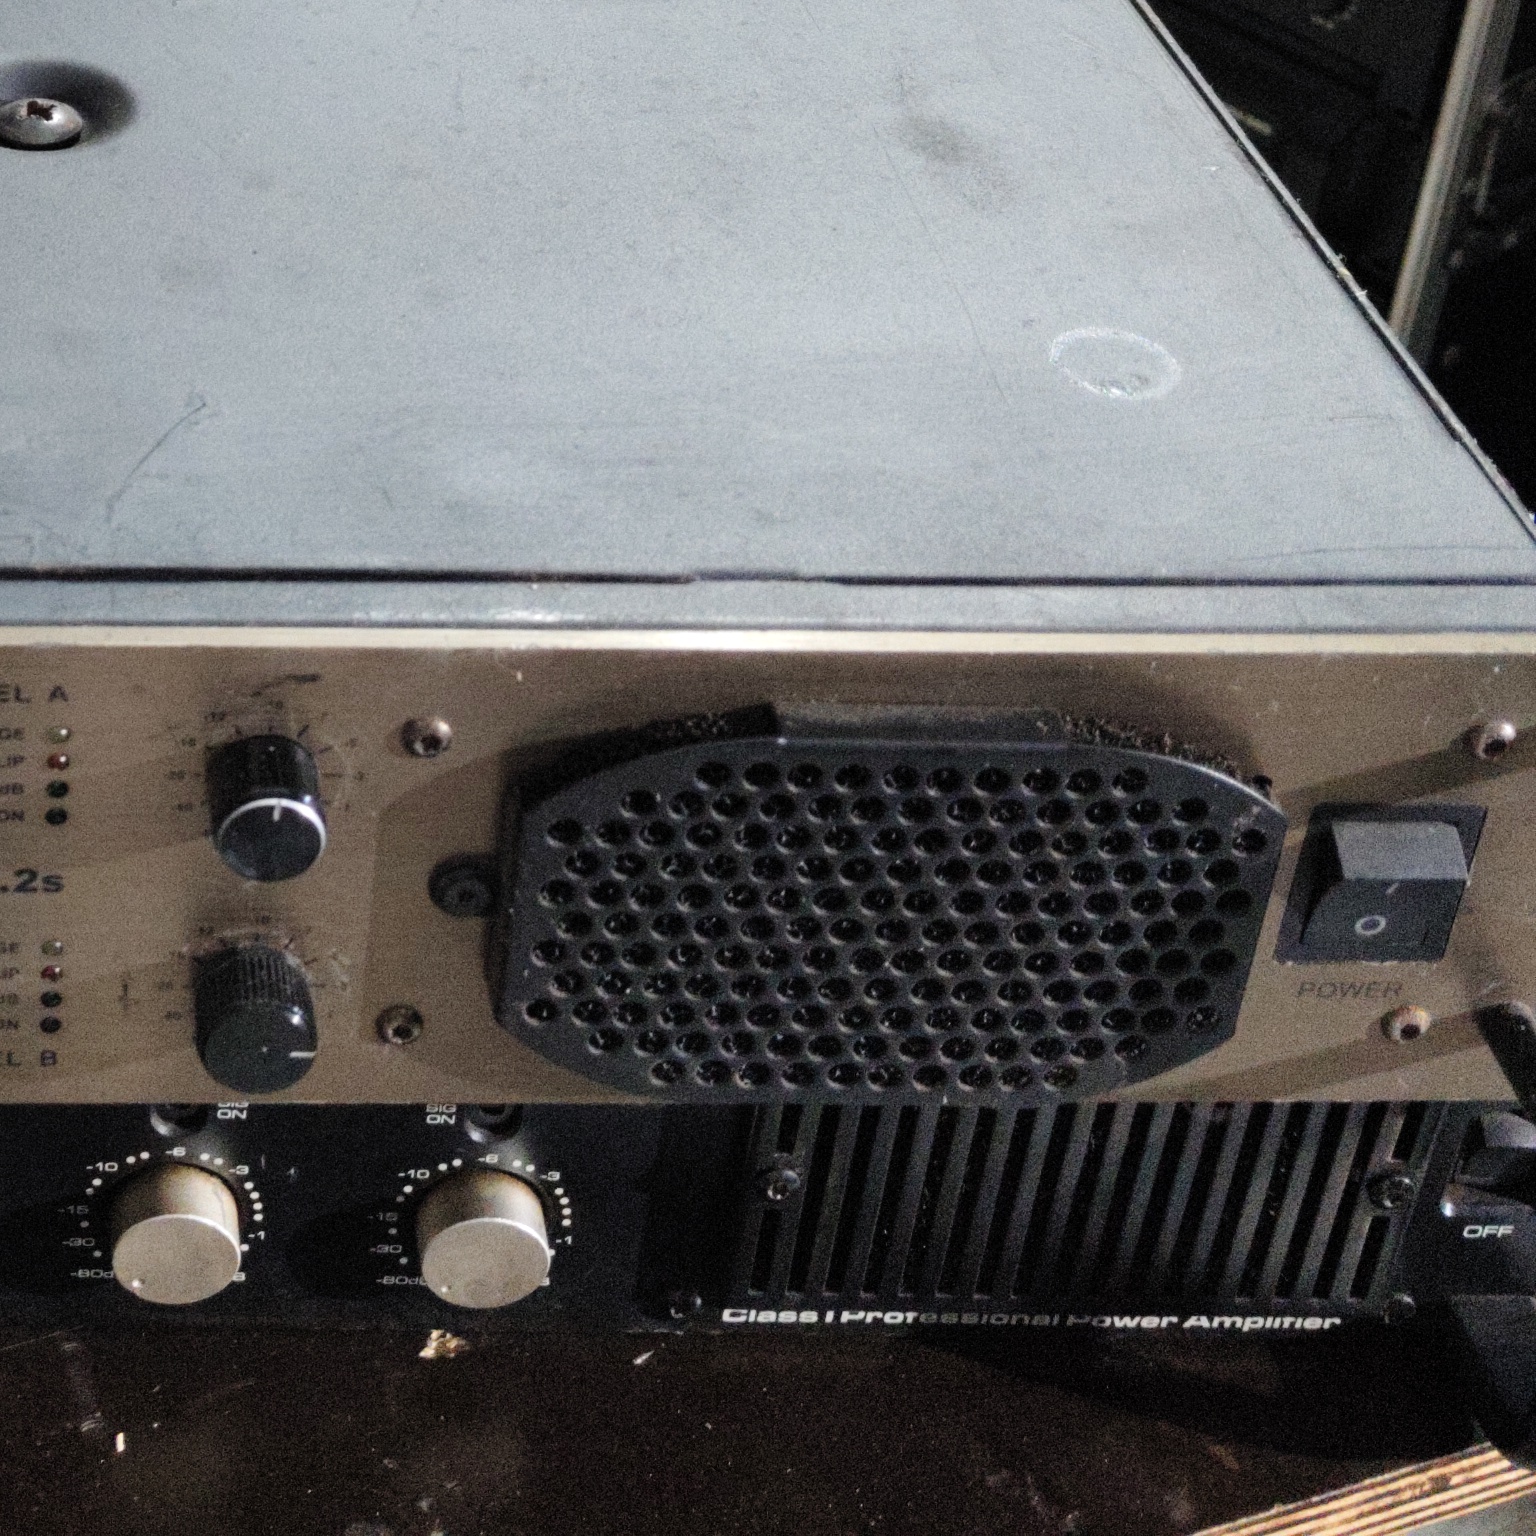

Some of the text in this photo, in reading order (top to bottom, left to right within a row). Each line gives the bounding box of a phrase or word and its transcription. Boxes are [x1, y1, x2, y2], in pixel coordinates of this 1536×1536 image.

[48, 685, 69, 703] A
[1296, 980, 1404, 999] POWER
[40, 1049, 57, 1067] B
[216, 1109, 248, 1120] ON
[425, 1114, 456, 1125] ON
[165, 1147, 187, 1157] -6
[477, 1153, 499, 1163] -6
[85, 1161, 119, 1172] -10
[228, 1165, 250, 1175] -3
[397, 1169, 431, 1180] -10
[539, 1171, 561, 1182] -3
[248, 1230, 266, 1240] -1
[1462, 1225, 1515, 1239] OFF
[62, 1237, 96, 1247] -30
[555, 1235, 573, 1246] -1
[369, 1244, 404, 1254] -30
[721, 1308, 819, 1324] Class
[839, 1309, 1060, 1327] Professional
[1066, 1314, 1179, 1329] Power
[1181, 1314, 1342, 1333] Amplifier
